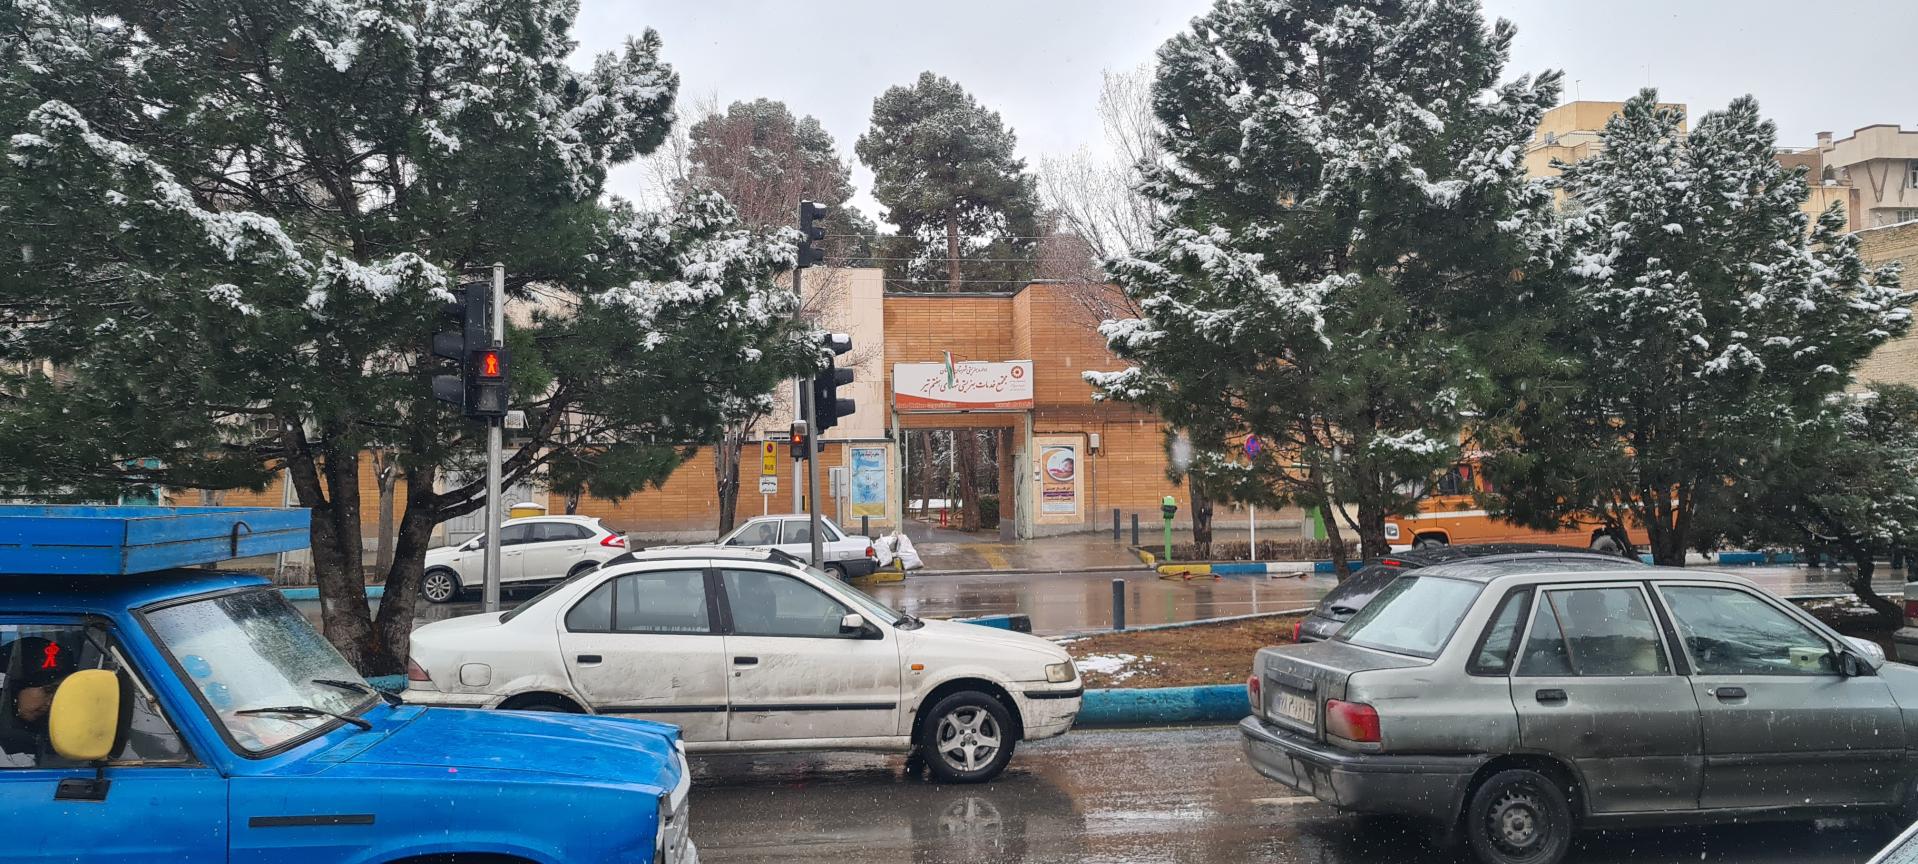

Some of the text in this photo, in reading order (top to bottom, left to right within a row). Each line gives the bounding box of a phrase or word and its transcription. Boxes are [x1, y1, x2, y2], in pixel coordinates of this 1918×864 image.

[919, 378, 931, 392] تیر
[928, 376, 941, 397] هفتم
[958, 379, 976, 393] بهزیستی
[975, 379, 996, 388] خدمات
[995, 375, 1008, 392] مجتمع
